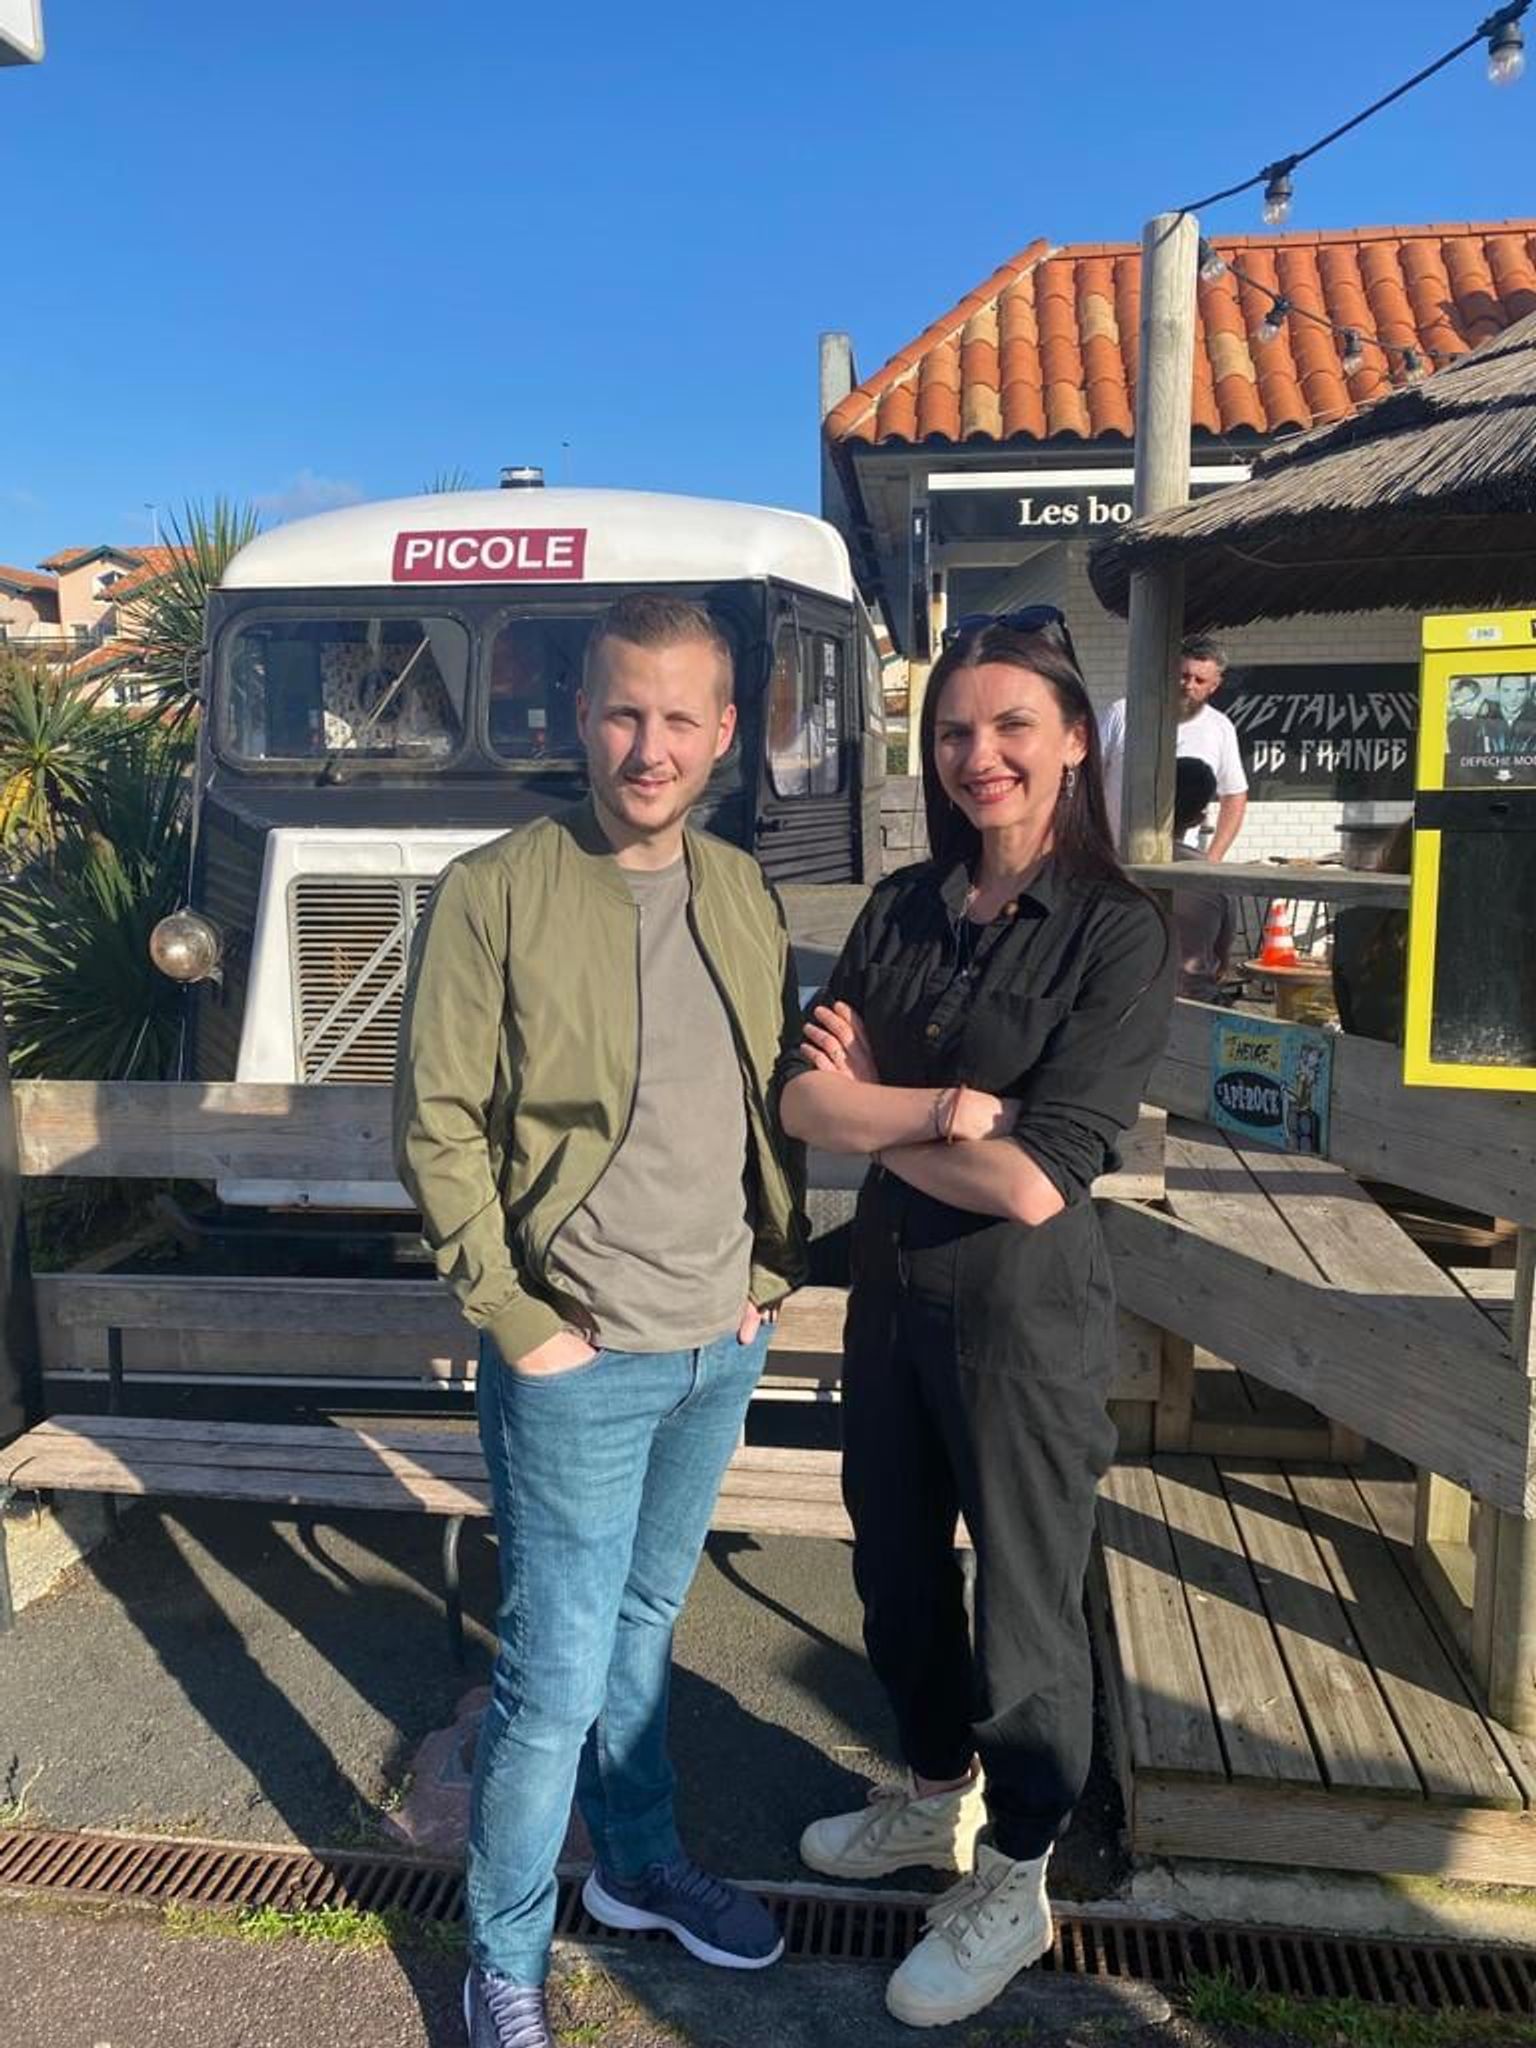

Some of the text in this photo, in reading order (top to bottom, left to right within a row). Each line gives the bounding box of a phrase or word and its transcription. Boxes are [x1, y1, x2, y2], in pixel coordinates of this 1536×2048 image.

[1018, 498, 1080, 525] Les
[404, 535, 575, 570] PICOLE
[1253, 738, 1408, 773] DE FRANCE
[1460, 755, 1511, 768] DEPECHE
